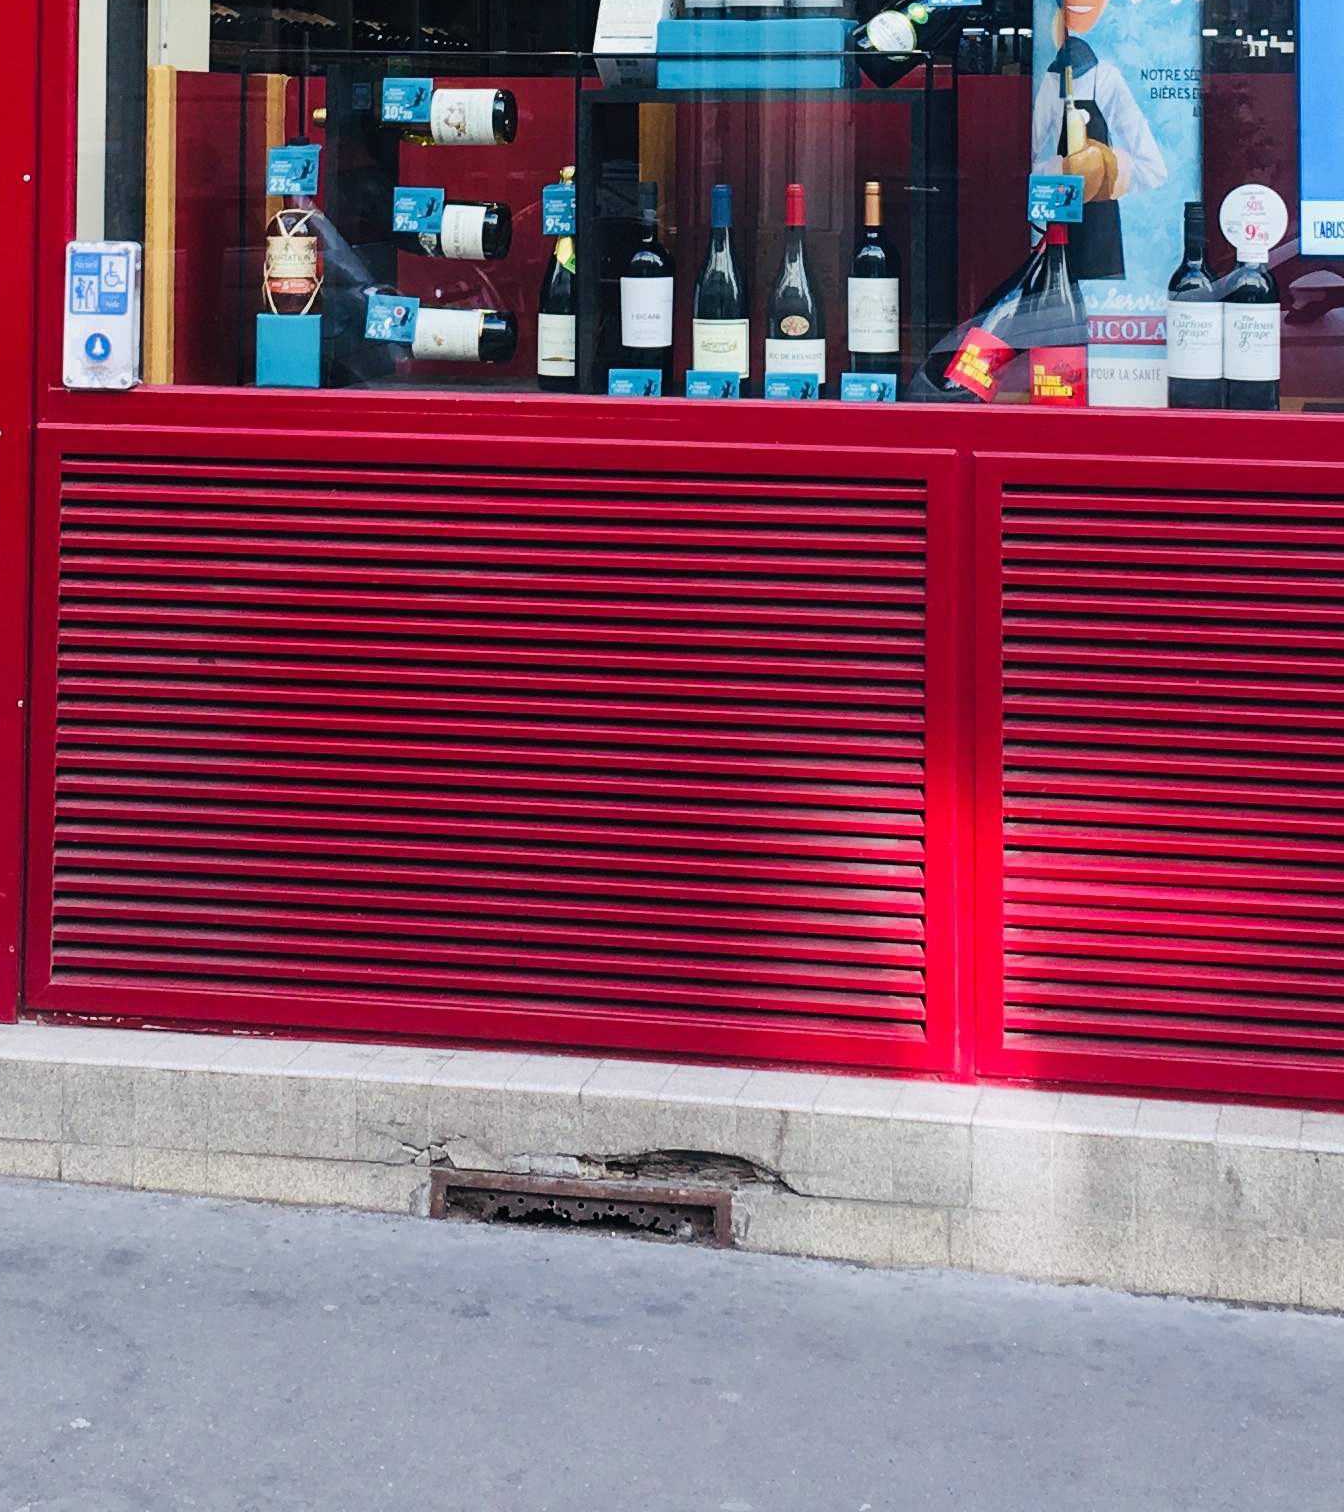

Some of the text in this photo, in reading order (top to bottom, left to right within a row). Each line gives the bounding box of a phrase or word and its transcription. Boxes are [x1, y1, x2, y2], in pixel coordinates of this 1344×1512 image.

[1141, 68, 1181, 81] NOTRE
[1172, 318, 1213, 330] Curious
[1233, 320, 1274, 332] Curious
[1176, 328, 1209, 350] grape
[1238, 330, 1271, 353] grape
[1091, 369, 1116, 380] POUR
[1118, 369, 1129, 380] LA
